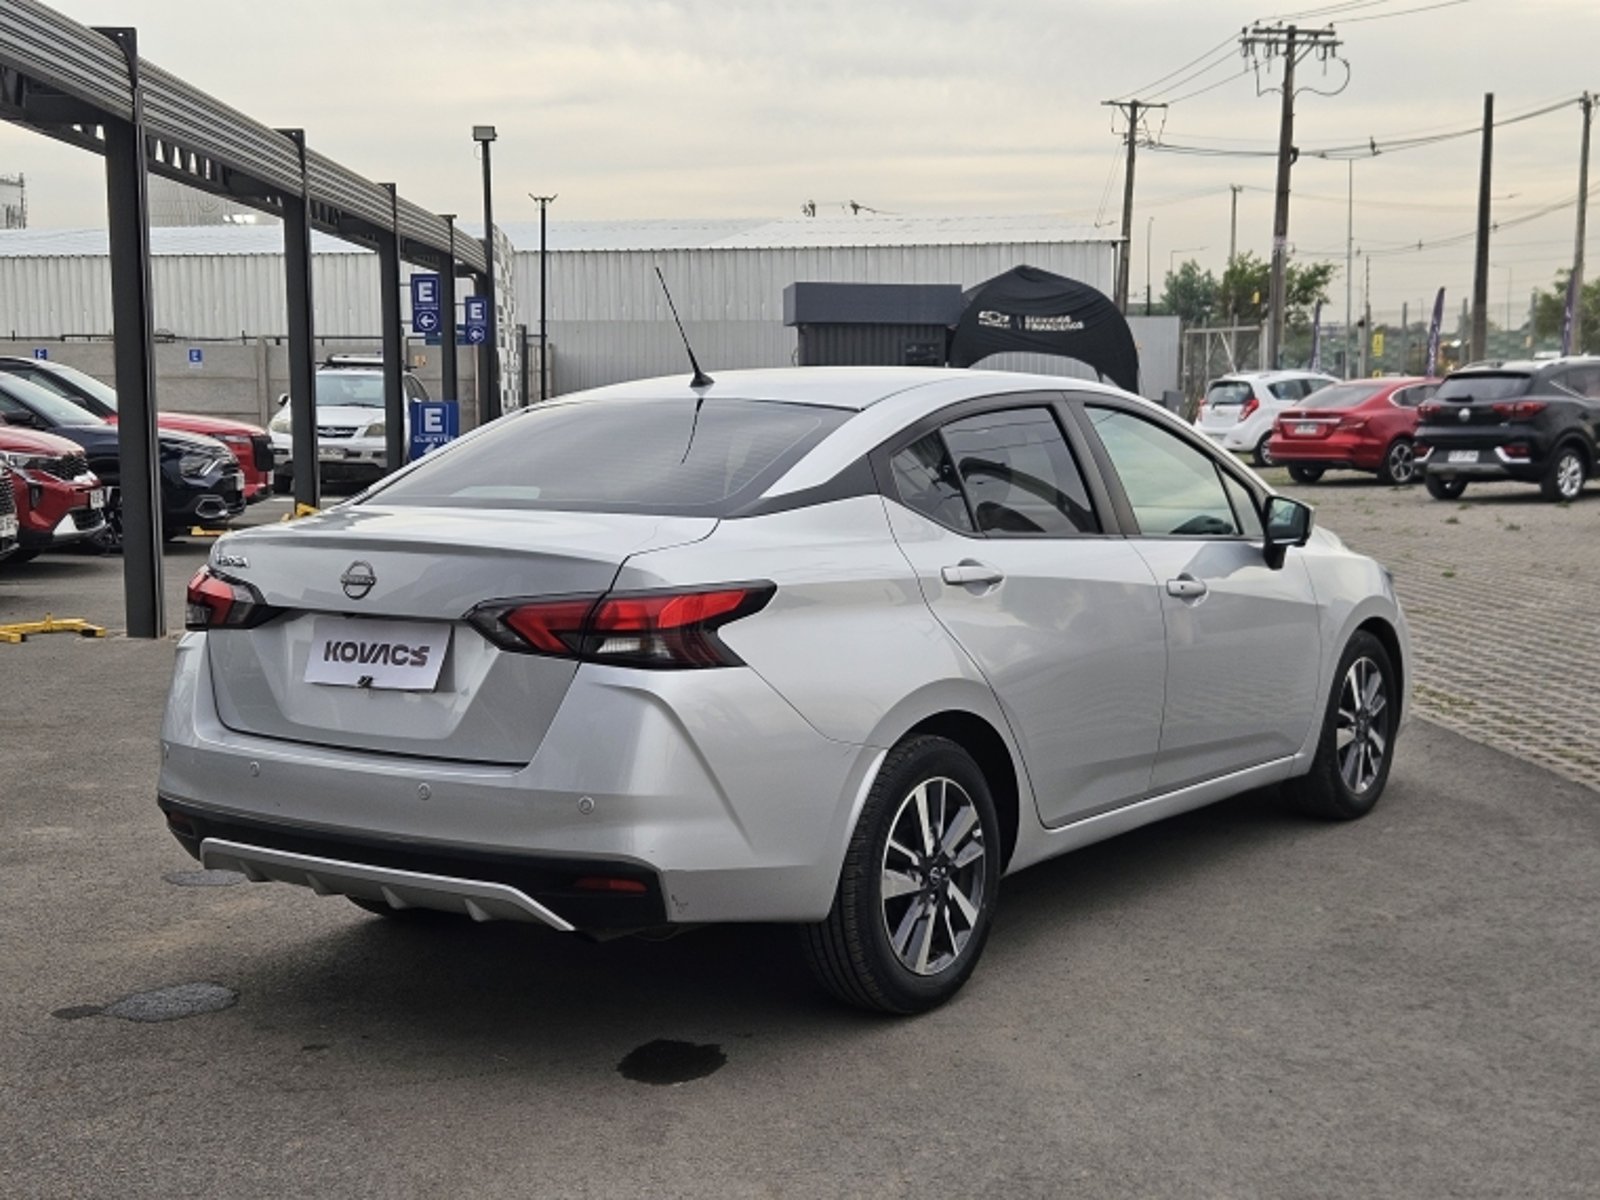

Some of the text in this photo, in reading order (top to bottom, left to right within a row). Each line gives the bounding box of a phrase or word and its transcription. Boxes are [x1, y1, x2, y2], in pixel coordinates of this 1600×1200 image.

[418, 282, 433, 301] E
[470, 303, 483, 319] E
[425, 408, 442, 432] E
[324, 640, 430, 667] KOVACS
